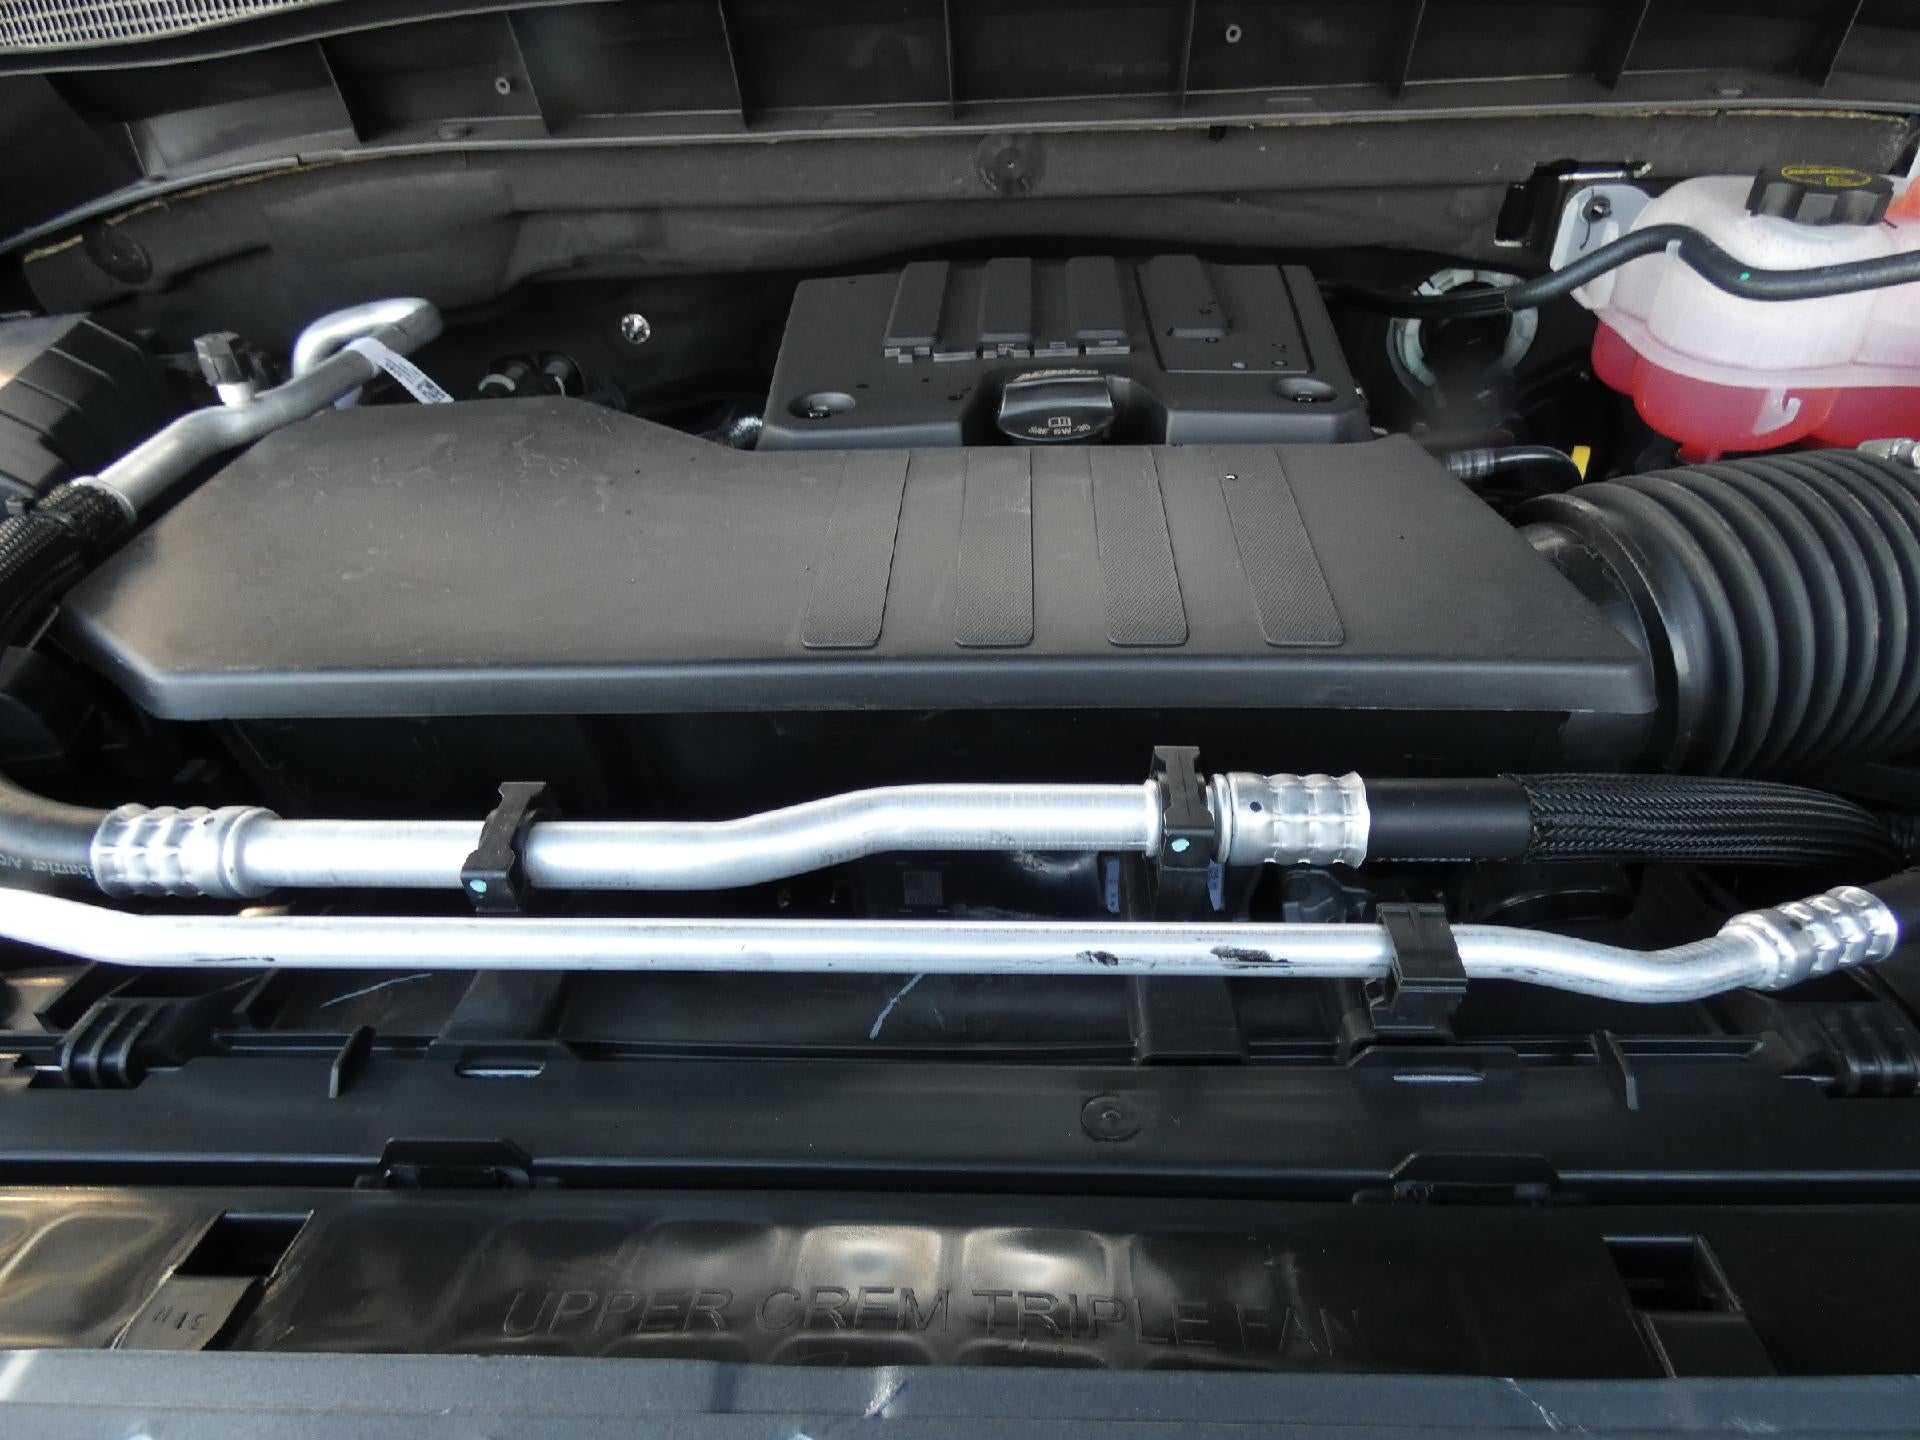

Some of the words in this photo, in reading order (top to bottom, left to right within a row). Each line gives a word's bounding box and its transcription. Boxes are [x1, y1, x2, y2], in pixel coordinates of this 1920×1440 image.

[502, 1286, 733, 1338] UPPER
[755, 1286, 950, 1332] CRFM
[971, 1289, 1218, 1347] TRIPLE
[1234, 1302, 1371, 1359] FAN
